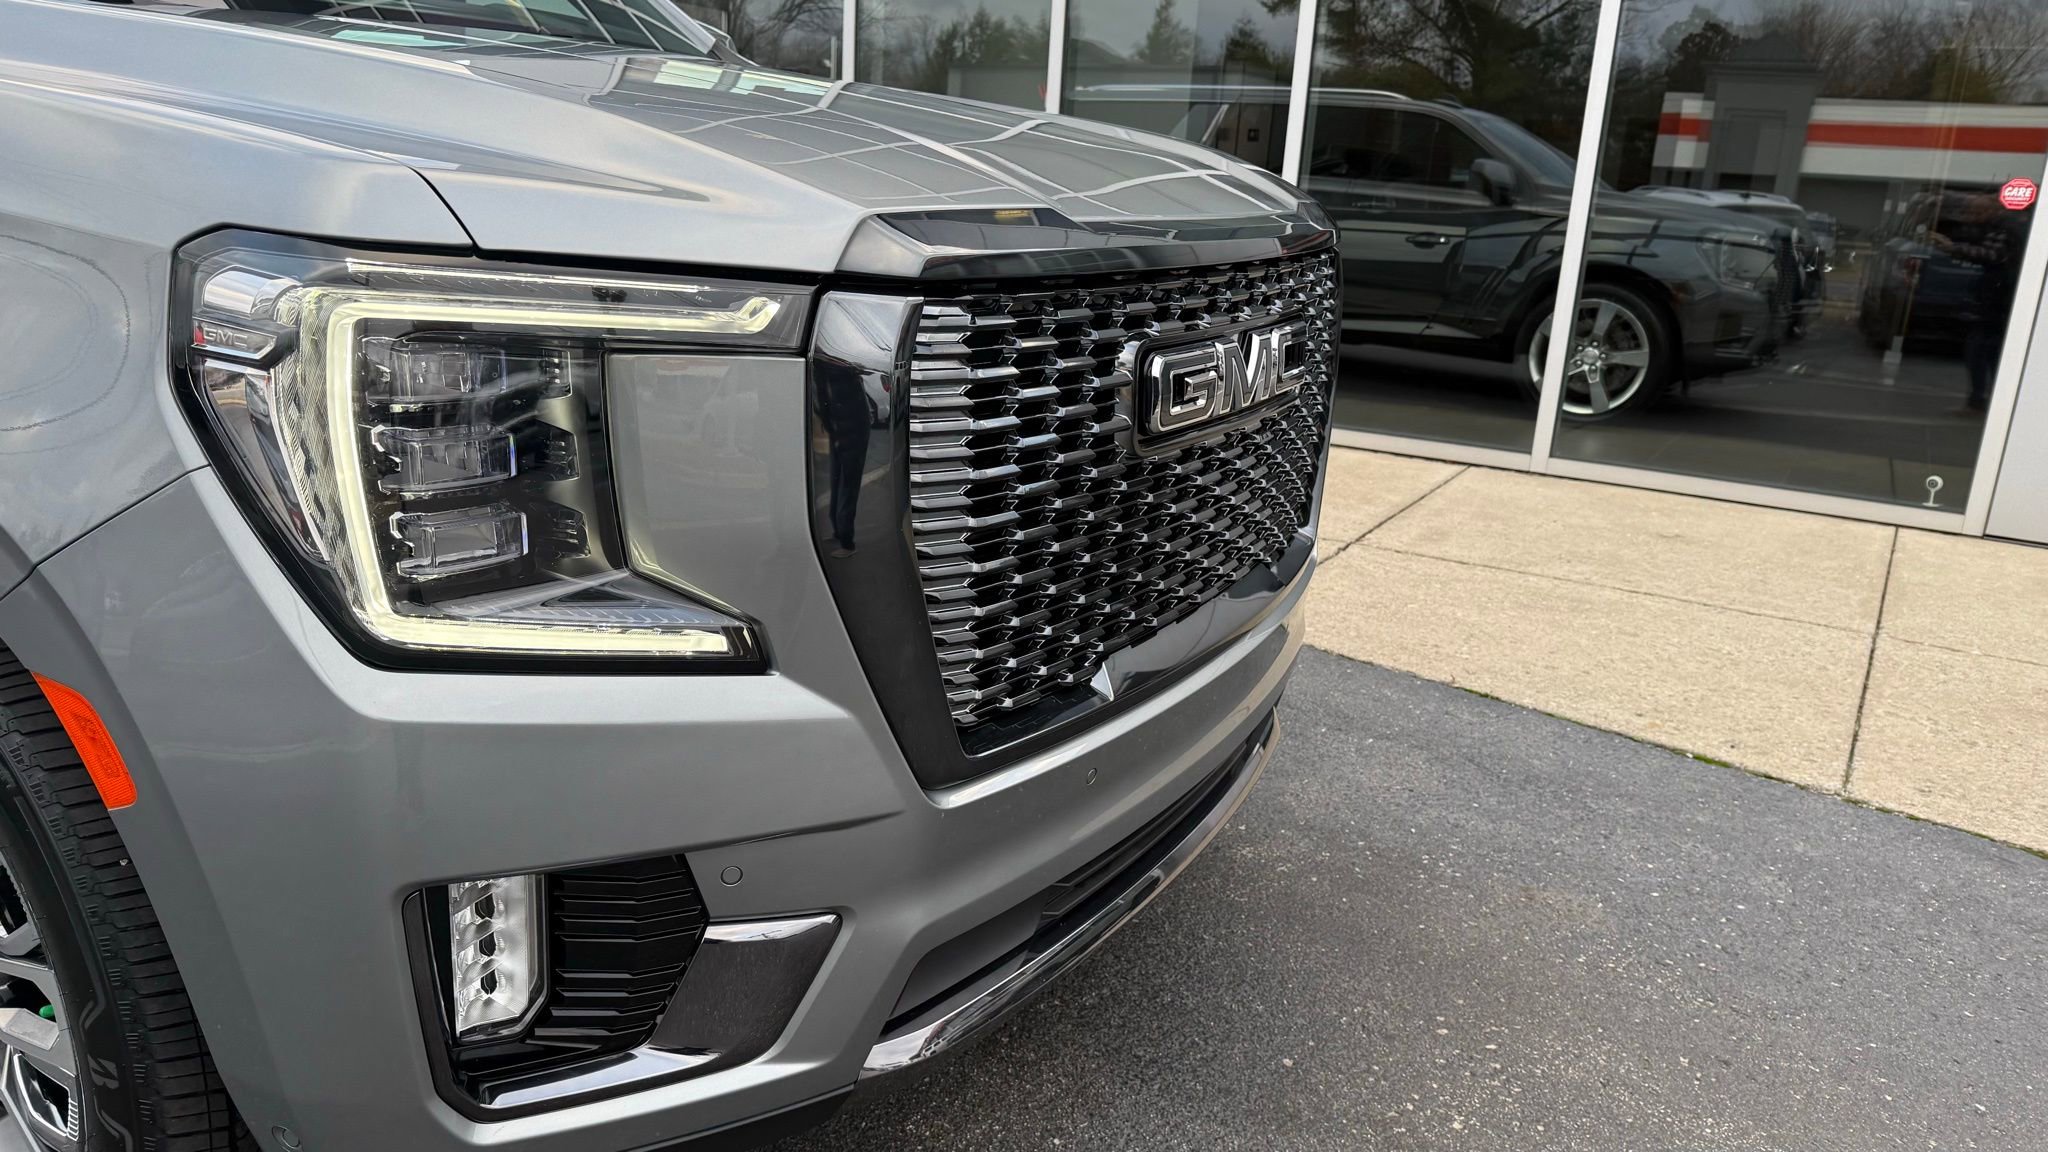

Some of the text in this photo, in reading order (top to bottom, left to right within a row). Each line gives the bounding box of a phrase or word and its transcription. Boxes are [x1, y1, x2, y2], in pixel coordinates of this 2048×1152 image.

[2004, 186, 2033, 197] CARE
[203, 327, 248, 347] GMC
[1151, 327, 1307, 433] GMC
